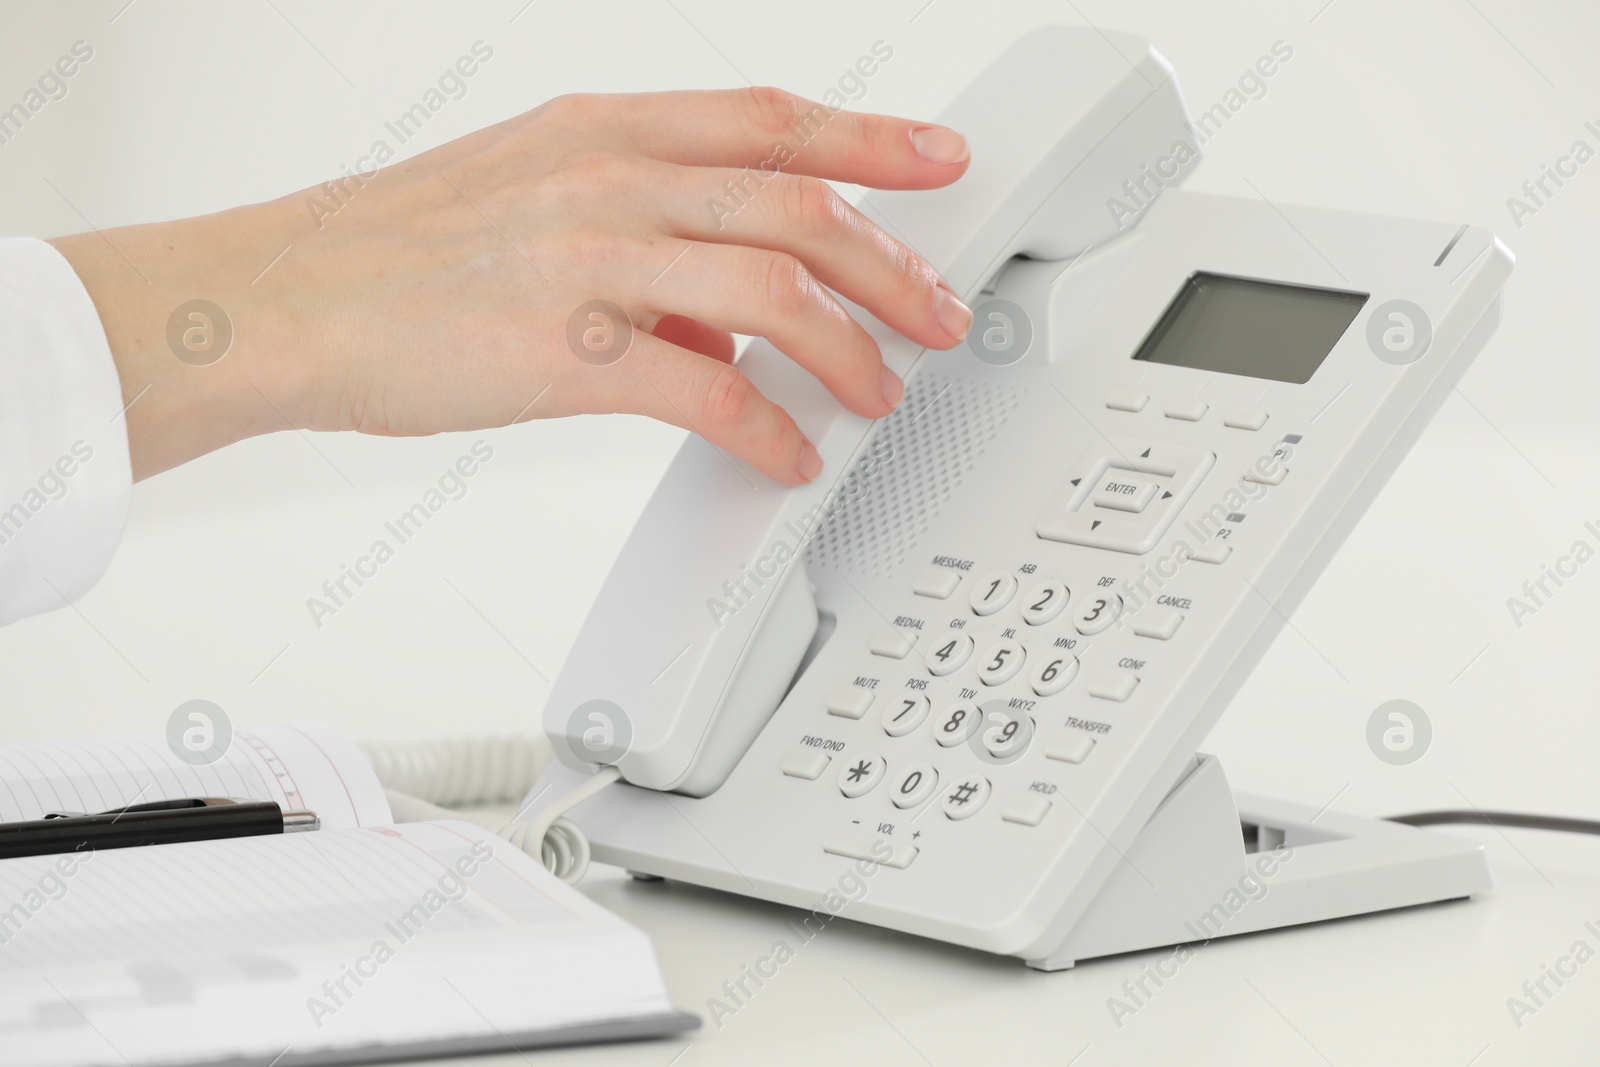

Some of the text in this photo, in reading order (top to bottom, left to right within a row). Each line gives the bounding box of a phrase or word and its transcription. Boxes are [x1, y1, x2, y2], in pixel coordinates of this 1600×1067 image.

[1272, 449, 1288, 460] P1
[1104, 482, 1137, 496] ENTER
[1215, 528, 1232, 540] P2
[931, 555, 975, 571] MESSAGE
[983, 579, 1002, 601] 1
[1096, 576, 1117, 588] DEF
[1029, 588, 1054, 612] 2
[1156, 594, 1193, 610] CANCEL
[1082, 599, 1107, 622] 3
[892, 615, 925, 631] REDIAL
[949, 618, 967, 630] GHI
[1000, 627, 1017, 639] JKL
[934, 639, 958, 663] 4
[1052, 637, 1077, 650] MNO
[986, 648, 1012, 672] 5
[1118, 657, 1147, 671] CONF
[1040, 659, 1064, 683] 6
[852, 676, 881, 690] MUTE
[905, 678, 930, 691] PQRS
[958, 687, 979, 700] TUV
[891, 699, 917, 722] 7
[1008, 697, 1037, 712] WXYZ
[943, 709, 967, 733] 8
[1064, 716, 1113, 735] TRANSFER
[995, 720, 1019, 744] 9
[799, 735, 846, 752] FWD/DND
[900, 770, 923, 795] 0
[1028, 781, 1057, 795] HOLD
[948, 781, 979, 807] #
[877, 822, 895, 836] VOL
